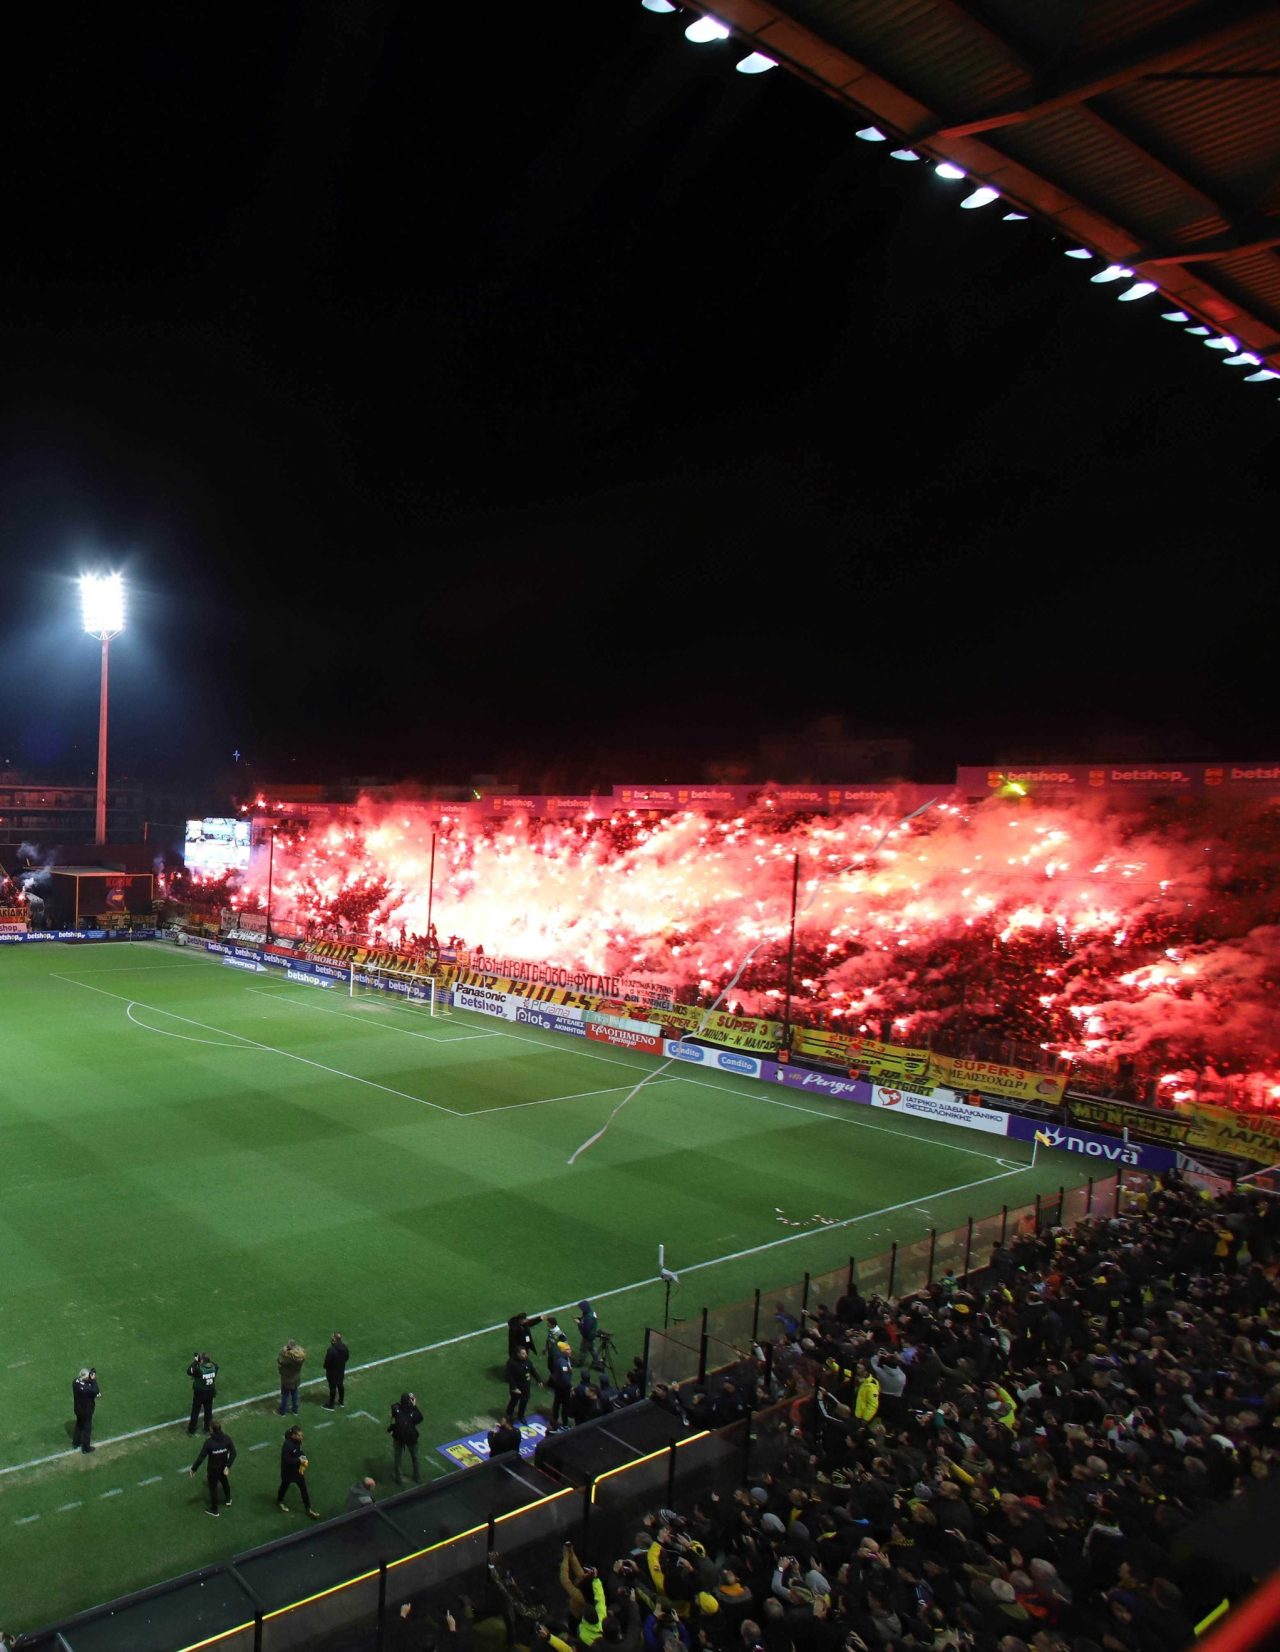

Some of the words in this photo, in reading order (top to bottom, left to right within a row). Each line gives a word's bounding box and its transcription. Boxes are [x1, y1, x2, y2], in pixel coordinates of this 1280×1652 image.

[312, 953, 348, 968] MORRIS
[287, 968, 330, 988] betshop.gr
[315, 964, 347, 981] betshop.gr
[455, 983, 507, 1004] Panasonic
[554, 1023, 586, 1036] ΑΚΙΝΗΤΩΝ
[556, 1016, 585, 1028] ΑΓΓΕΛΙΕΣ
[692, 1019, 699, 1029] 3
[716, 1014, 758, 1034] SUPER
[759, 1023, 768, 1036] 3
[671, 1045, 700, 1058] Condito
[721, 1056, 752, 1070] Condito
[954, 1059, 1025, 1080] SUPER-3
[905, 1103, 972, 1122] ΘΕΣΣΑΛΟΝΙΚΗΣ
[906, 1096, 937, 1109] ΙΑΤΡΙΚΟ
[938, 1103, 1004, 1122] ΔΙΑΒΑΛΚΑΝΙΚΟ
[1067, 1135, 1138, 1165] nova
